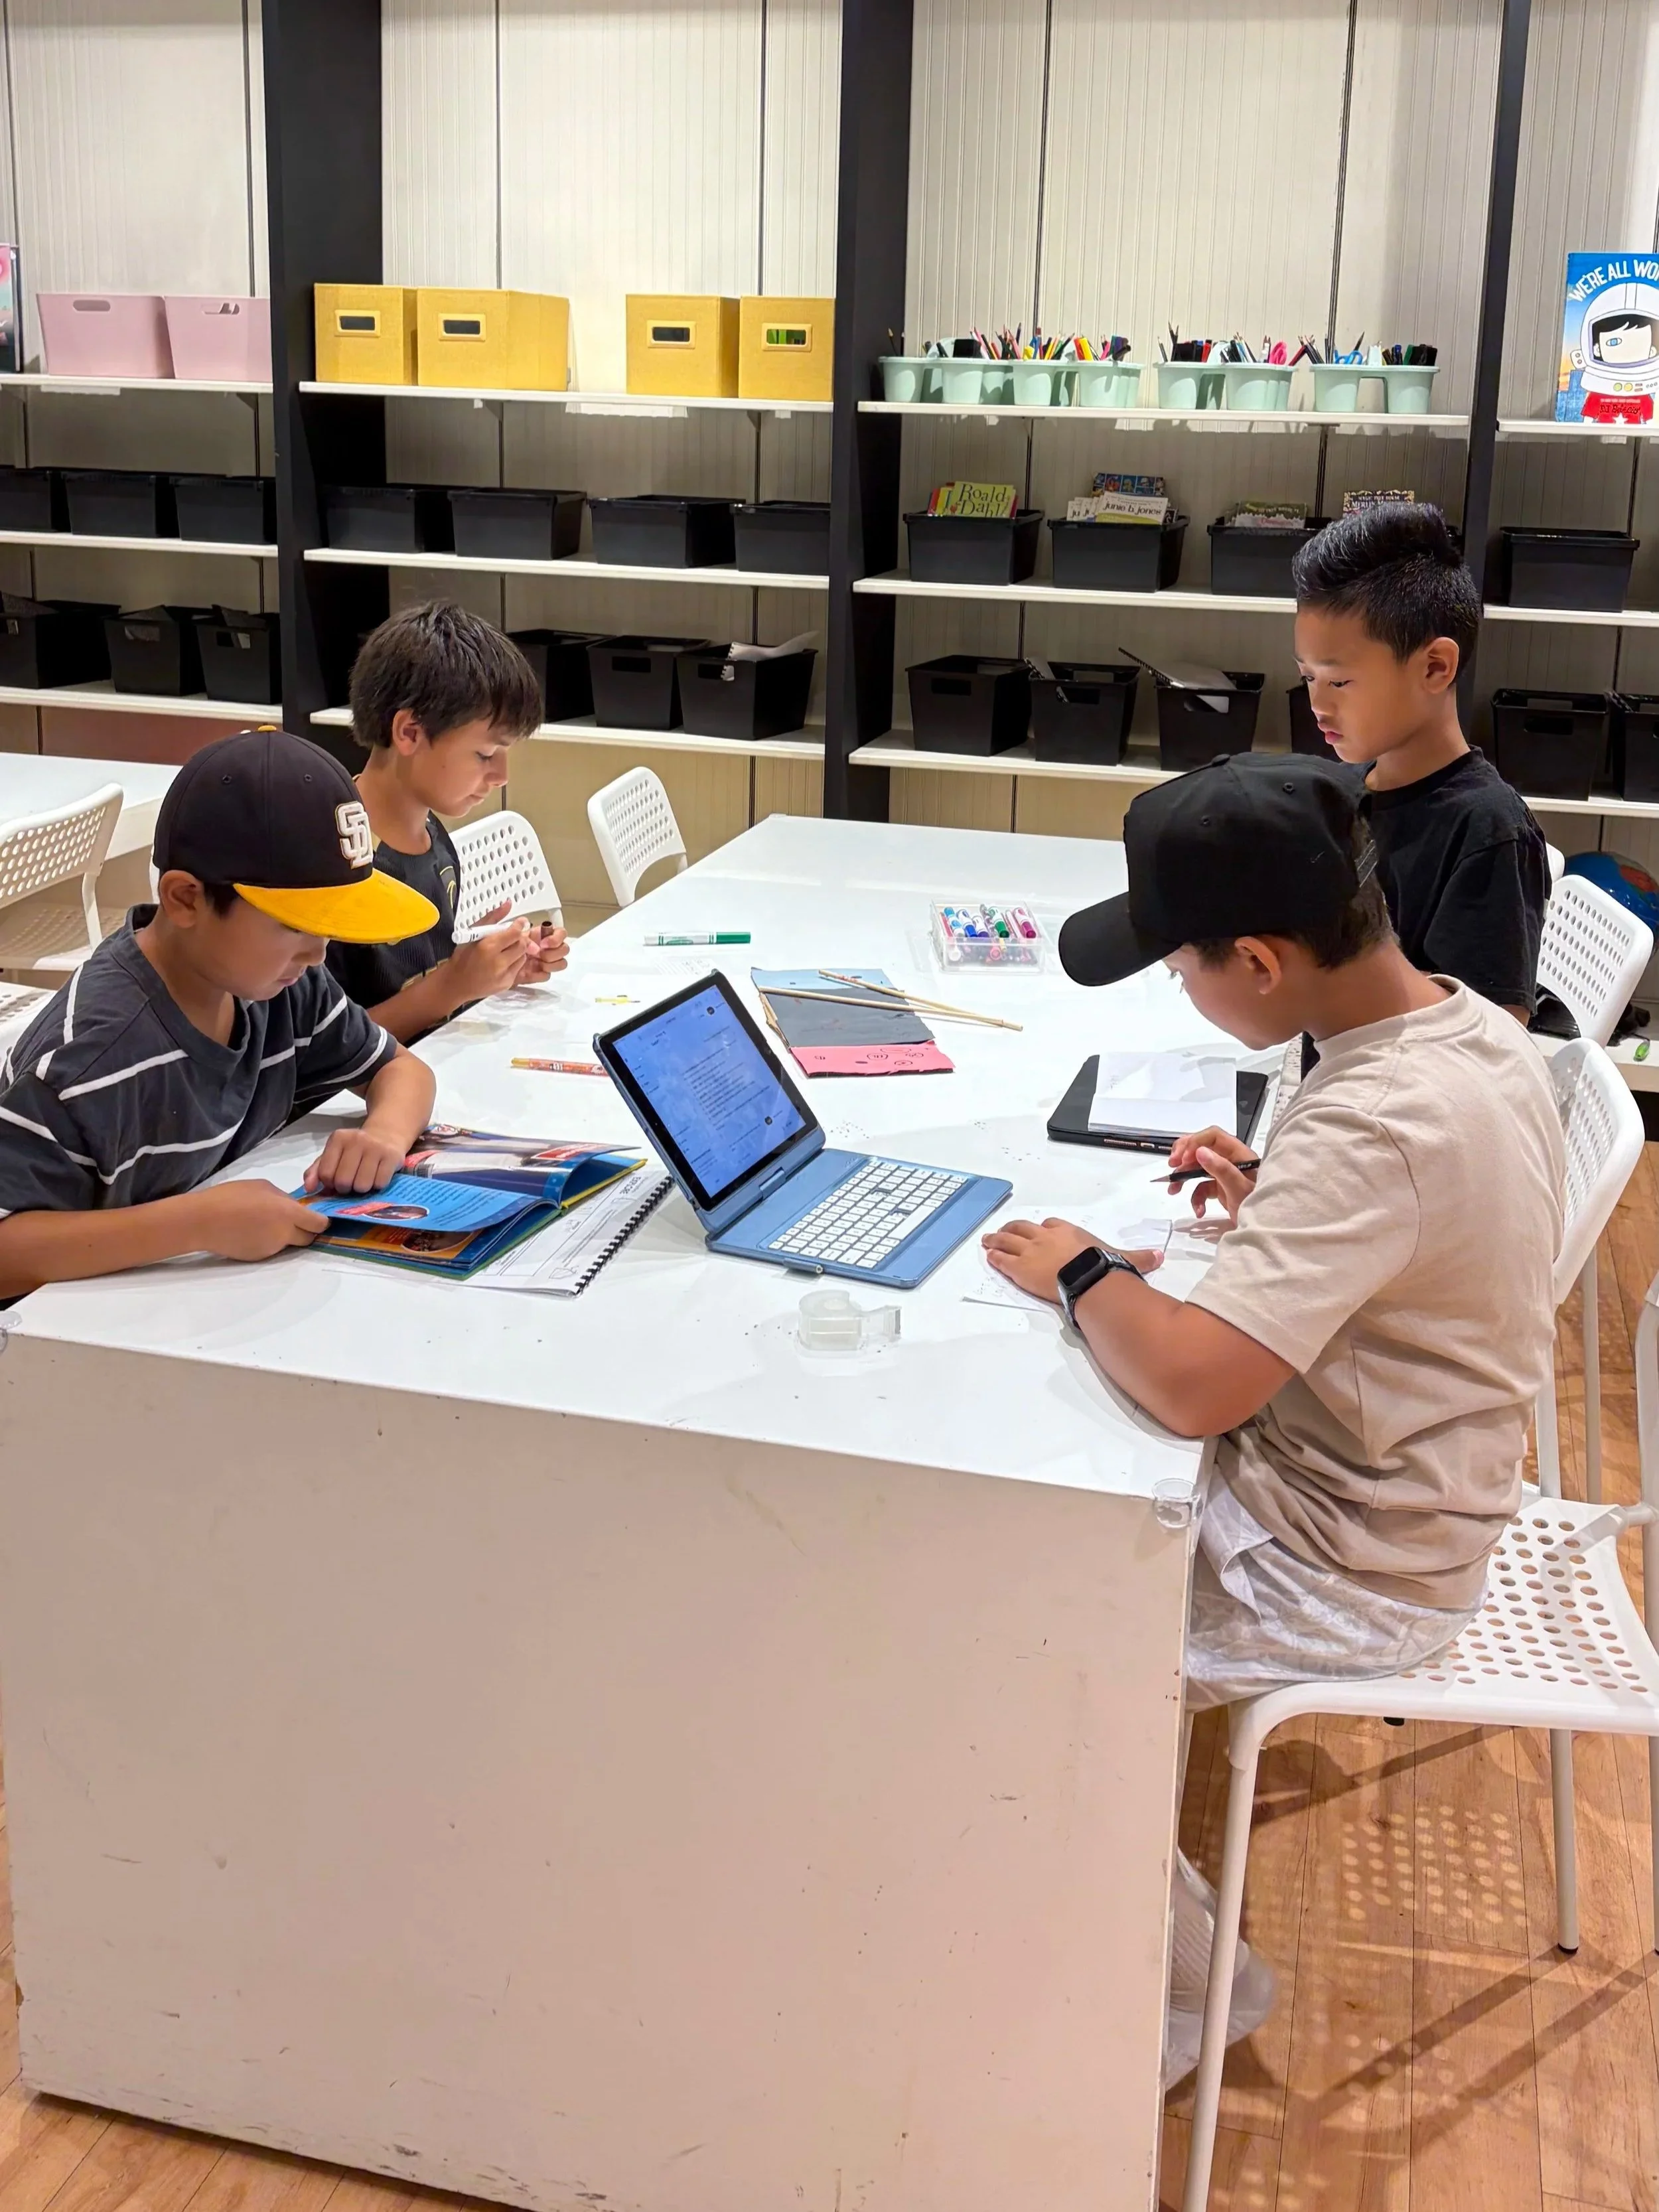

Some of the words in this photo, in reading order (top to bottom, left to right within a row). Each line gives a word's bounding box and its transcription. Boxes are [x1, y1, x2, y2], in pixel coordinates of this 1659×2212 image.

[1568, 266, 1608, 302] WE'RE
[1608, 260, 1631, 281] ALL
[959, 483, 1007, 502] Roald
[1103, 501, 1126, 511] junie
[1135, 506, 1162, 516] jones
